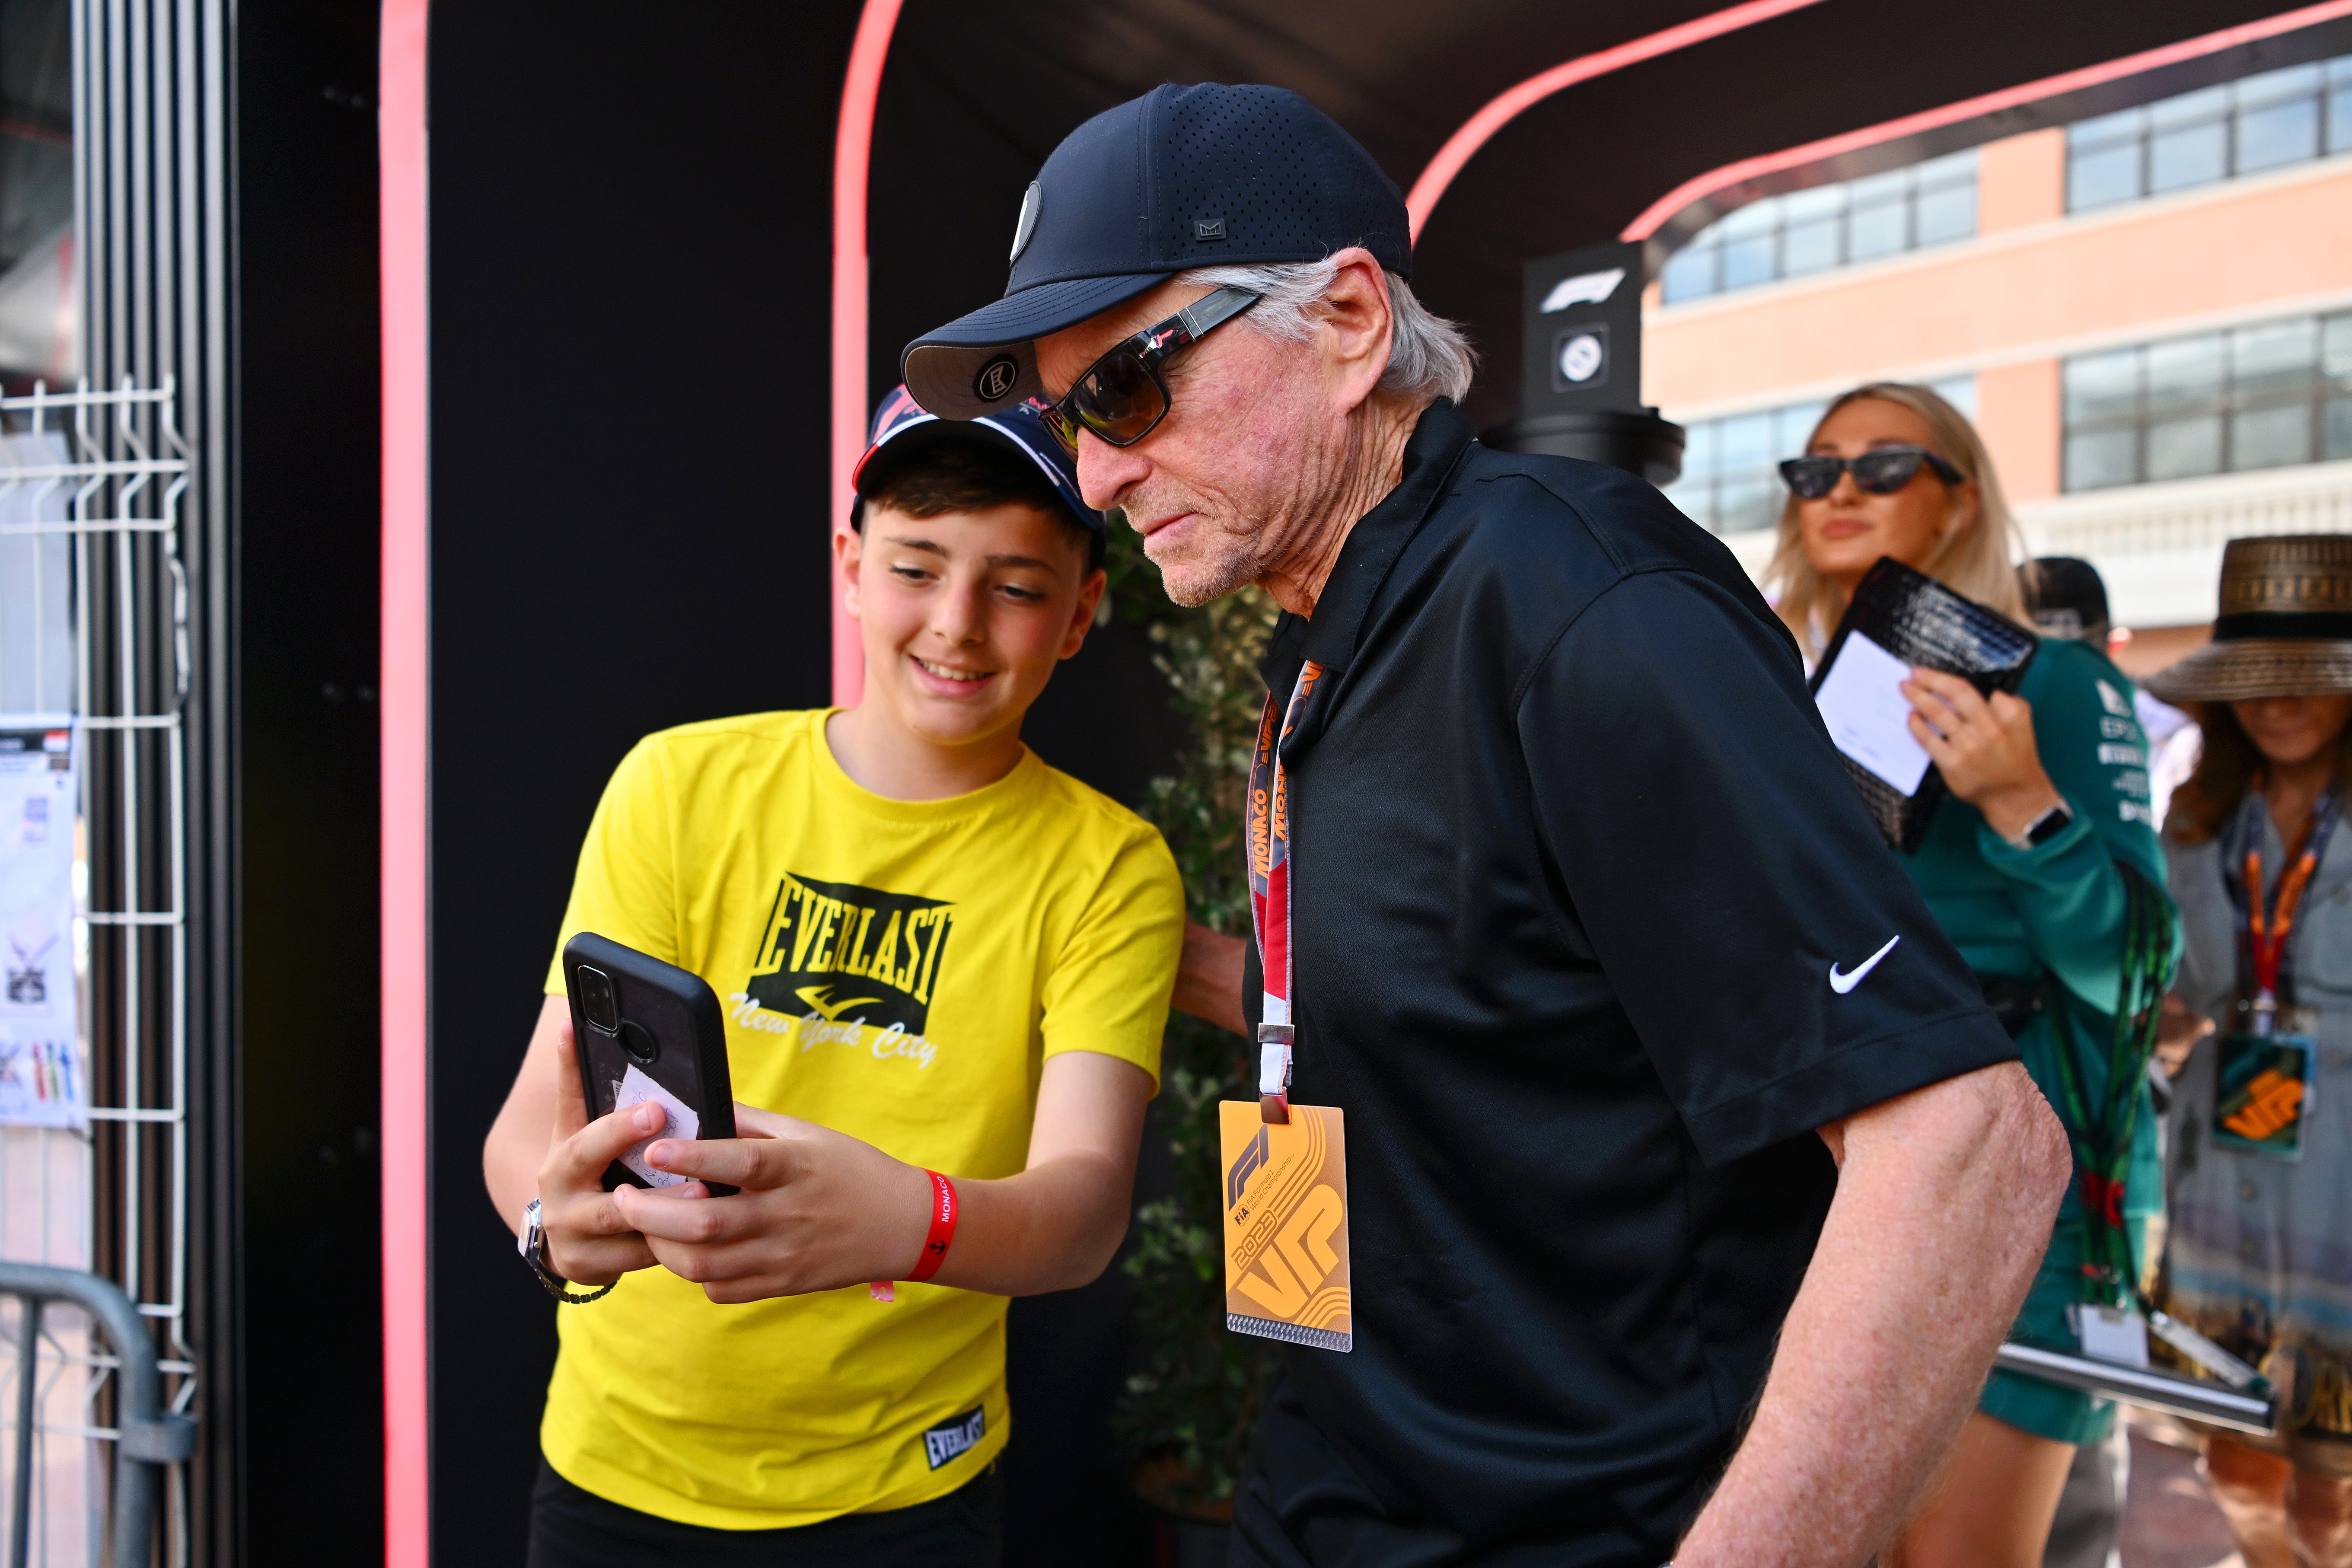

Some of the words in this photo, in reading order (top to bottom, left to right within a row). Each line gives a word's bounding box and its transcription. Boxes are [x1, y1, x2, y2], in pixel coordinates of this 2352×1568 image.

[1302, 661, 1323, 682] VI
[1252, 789, 1269, 880] MONACO
[1261, 719, 1273, 751] VIP
[755, 877, 956, 1004] EVERLAST
[730, 992, 790, 1035] New
[800, 1009, 866, 1053] York
[872, 1021, 938, 1069] City
[937, 1176, 951, 1223] MONACO
[1246, 1195, 1255, 1206] FIA
[1253, 1173, 1272, 1197] Formula
[1250, 1195, 1264, 1211] World
[1231, 1209, 1277, 1272] 2023
[1237, 1184, 1343, 1318] VIP
